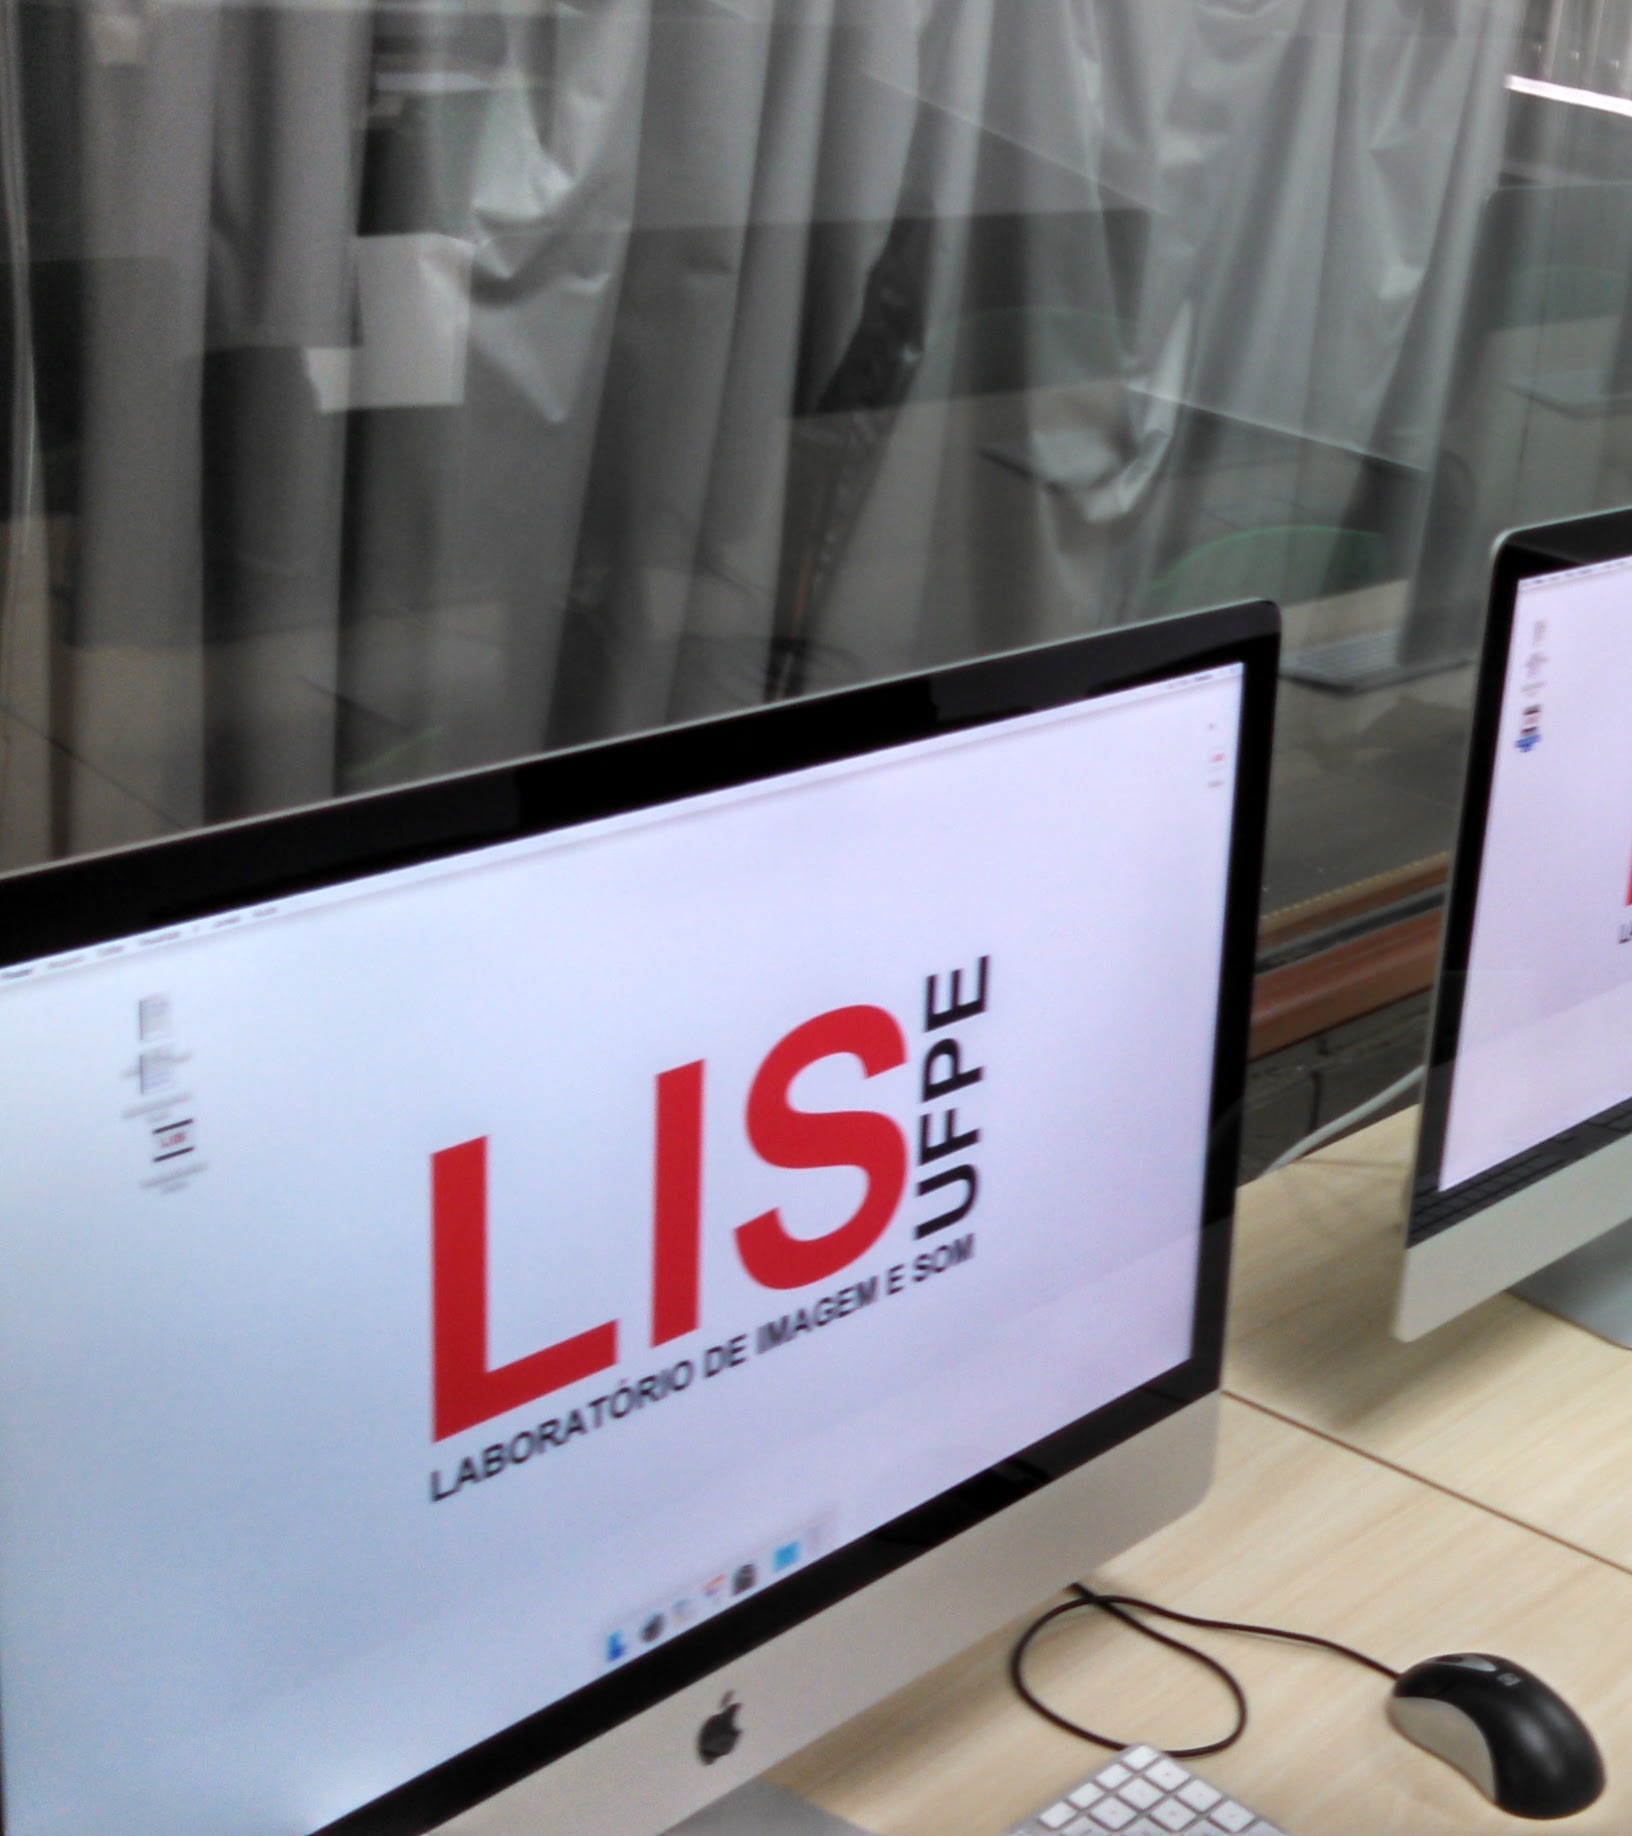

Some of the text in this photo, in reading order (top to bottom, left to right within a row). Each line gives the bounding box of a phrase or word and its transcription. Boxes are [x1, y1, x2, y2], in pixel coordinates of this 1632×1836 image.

[430, 1003, 908, 1443] LIS
[913, 954, 991, 1240] UFPE
[429, 1232, 976, 1503] LABORATÓRIO DE IMAGEM E SOM
